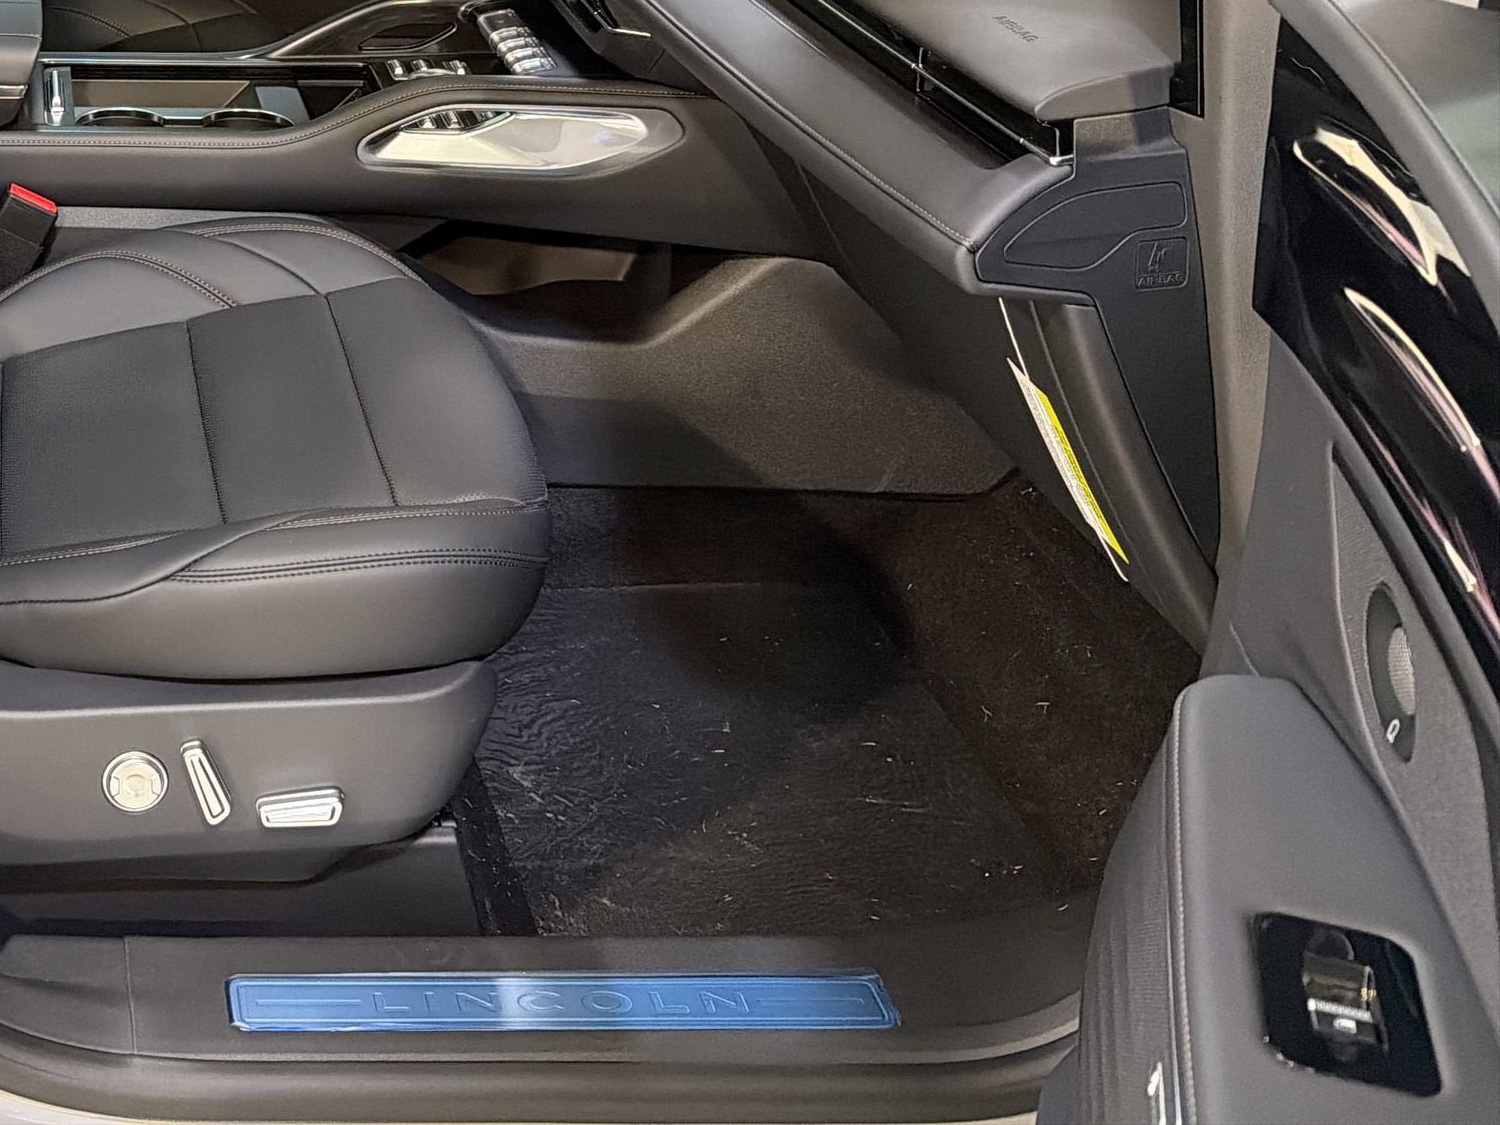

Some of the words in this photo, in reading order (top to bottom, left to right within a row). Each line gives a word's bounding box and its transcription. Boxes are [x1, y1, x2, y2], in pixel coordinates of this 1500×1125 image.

[991, 15, 1038, 43] AIRBAG
[1137, 273, 1185, 287] AIRBAG
[372, 989, 750, 1015] LINCOLN
